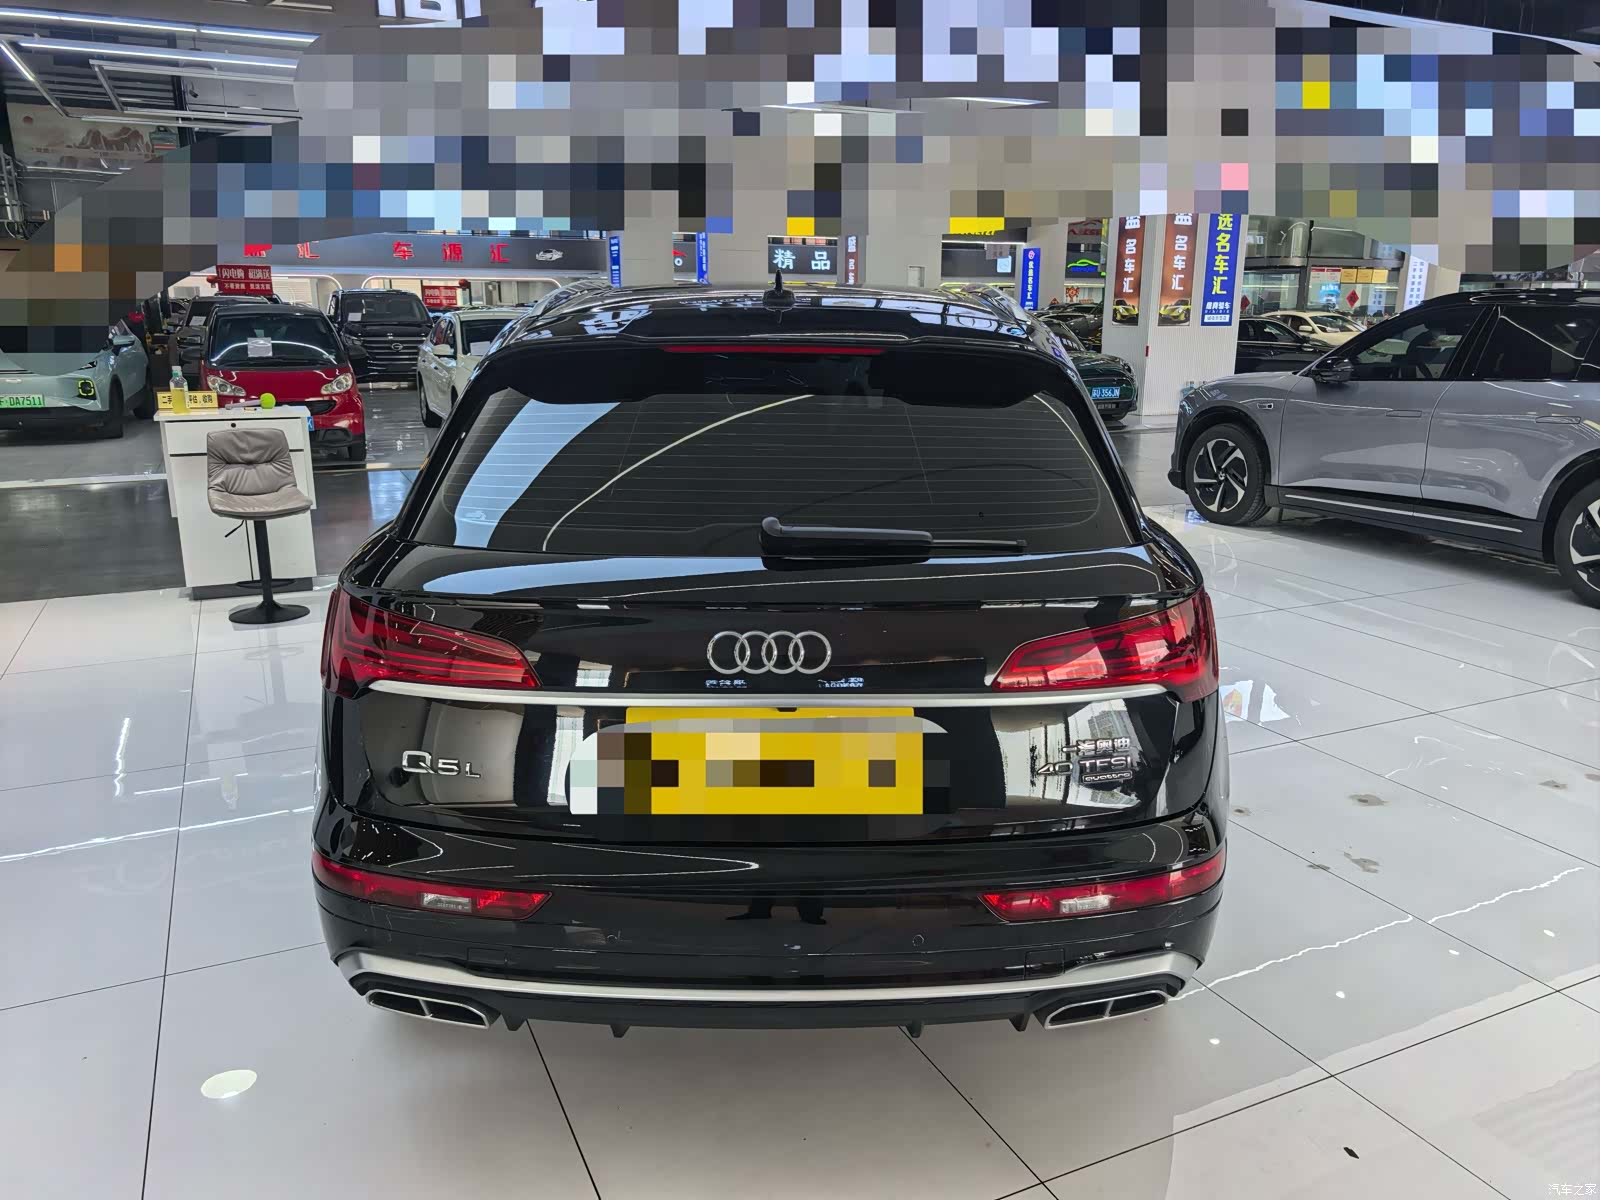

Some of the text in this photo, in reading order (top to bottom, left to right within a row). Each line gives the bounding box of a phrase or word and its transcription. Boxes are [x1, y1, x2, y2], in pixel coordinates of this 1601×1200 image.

[392, 240, 511, 263] 车源汇
[773, 249, 831, 270] 精品
[1038, 756, 1131, 775] 40 TFSI
[1084, 772, 1131, 782] quattro
